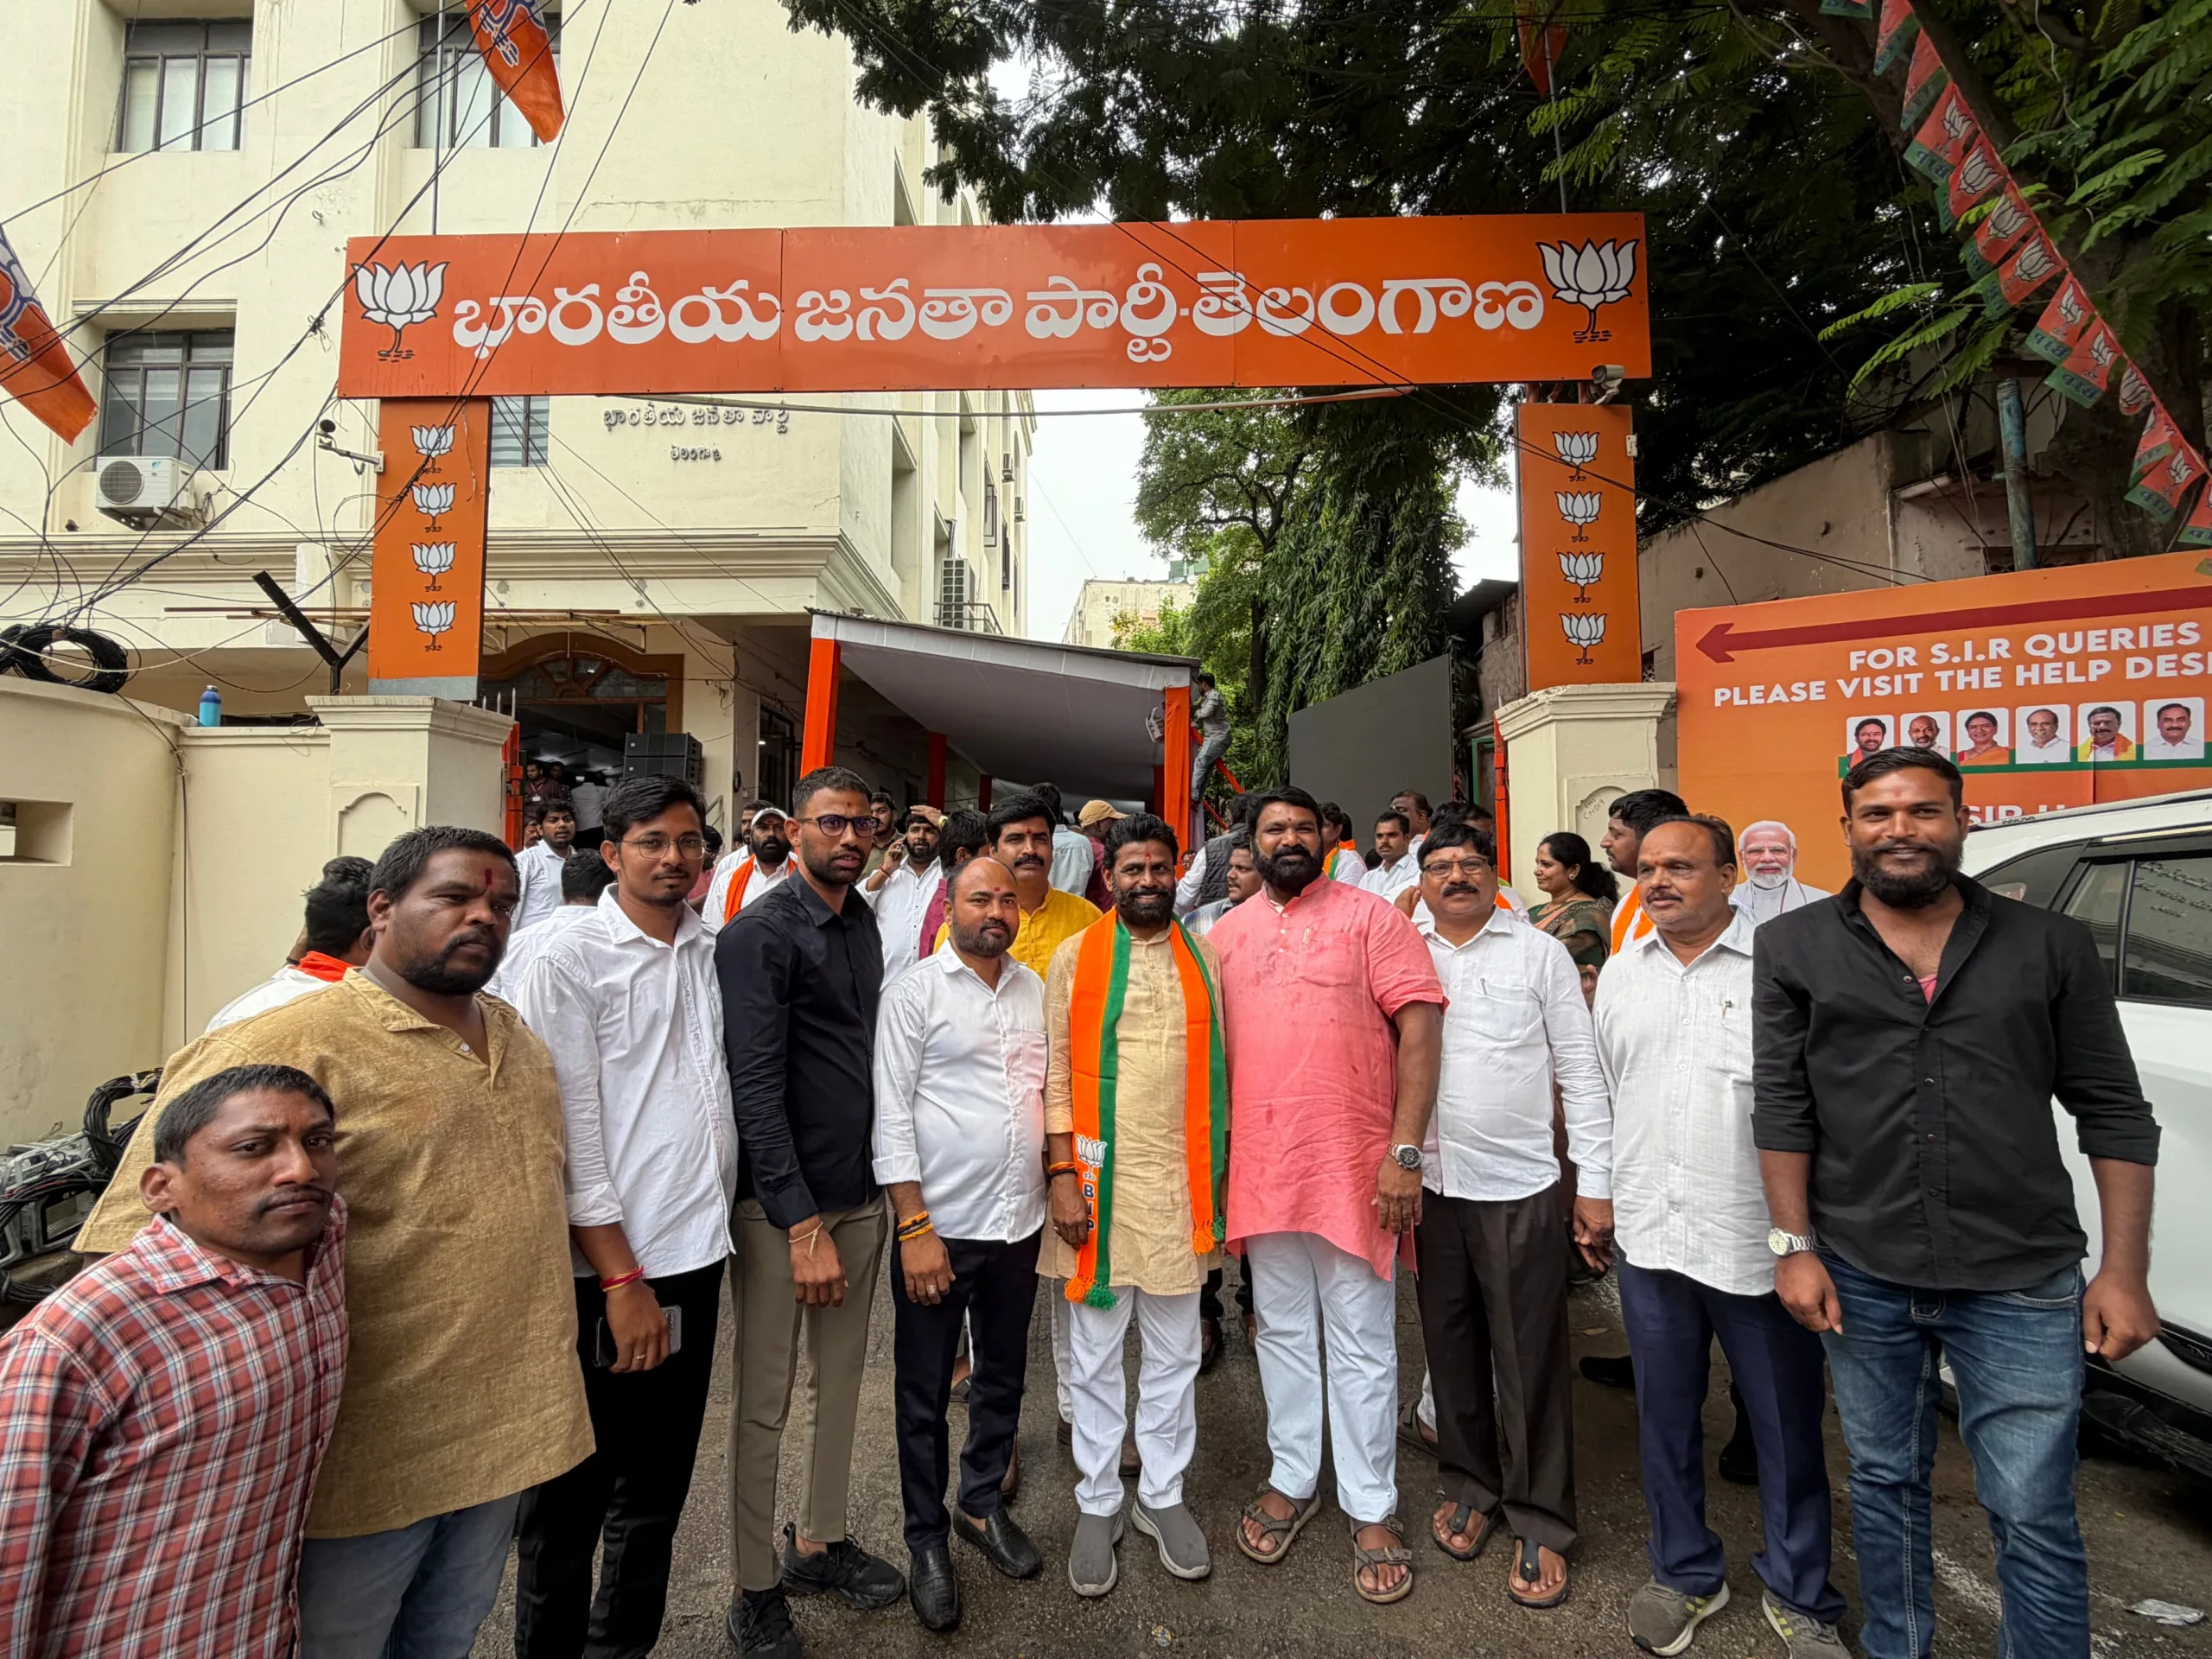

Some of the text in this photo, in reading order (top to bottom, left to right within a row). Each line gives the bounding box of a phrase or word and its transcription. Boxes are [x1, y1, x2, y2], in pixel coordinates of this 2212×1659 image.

[453, 271, 781, 359] భారతీయ
[794, 278, 1014, 342] జనతా
[604, 401, 685, 431] భారతీయ
[1849, 621, 2201, 671] FOR S.I.R QUERIES
[1714, 652, 2212, 707] PLEASE VISIT THE HELP DES
[2001, 815, 2037, 825] INNOVA
